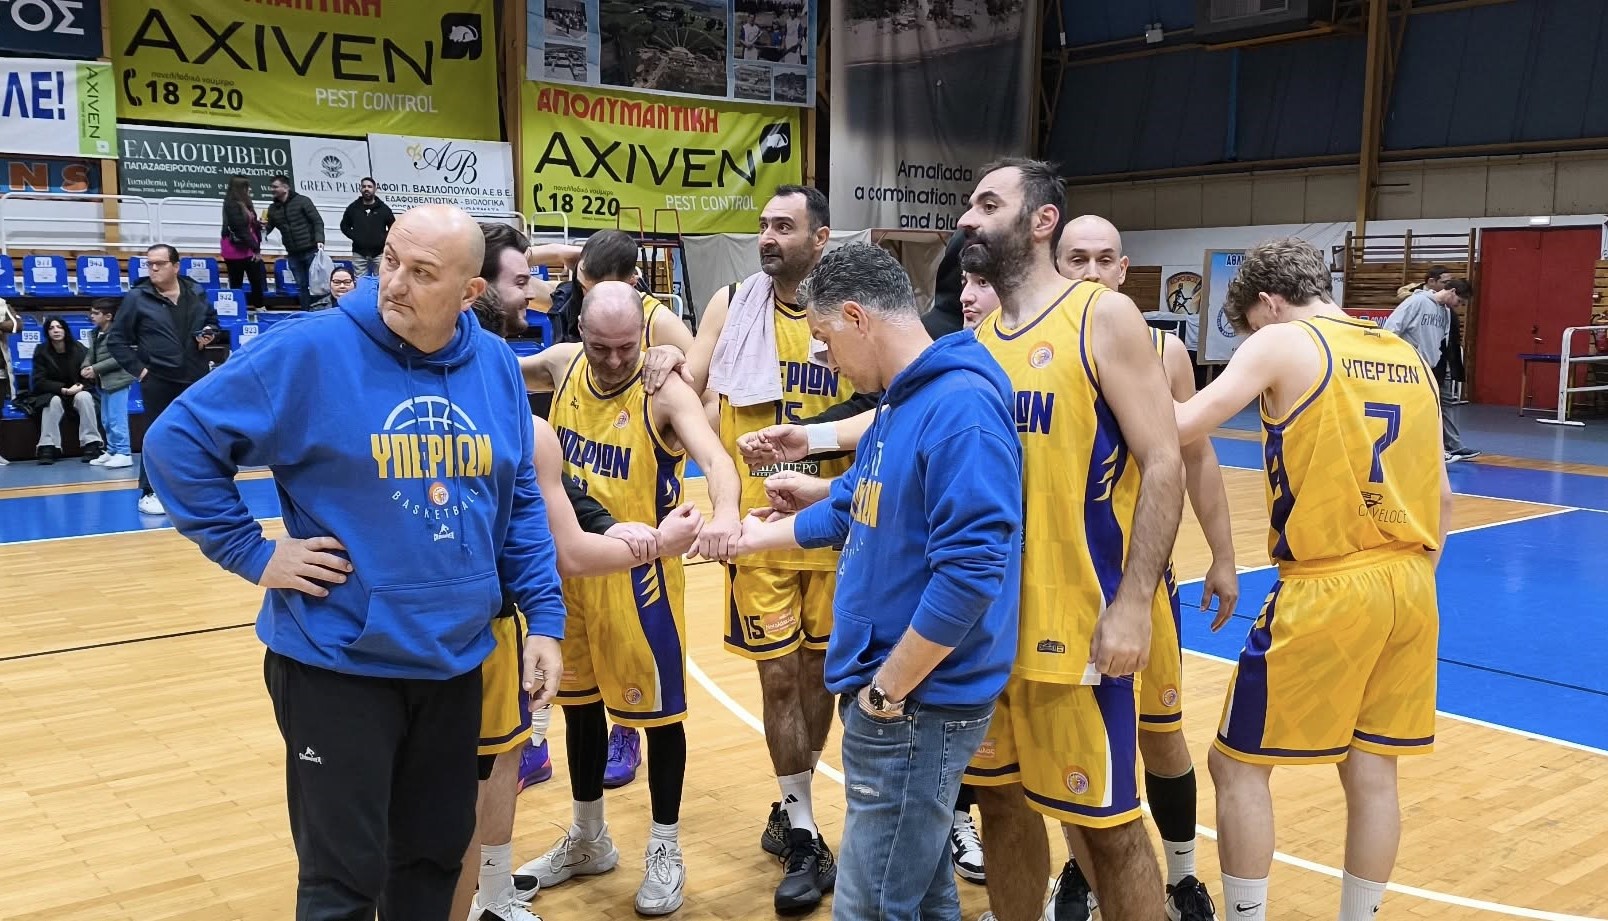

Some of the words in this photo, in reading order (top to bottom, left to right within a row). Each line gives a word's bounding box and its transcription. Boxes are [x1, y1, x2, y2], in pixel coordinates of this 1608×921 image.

[0, 0, 85, 35] ΟΣ
[124, 8, 433, 85] AXIVEN
[86, 66, 101, 139] AXIVEN
[145, 80, 180, 105] 18
[191, 84, 243, 111] 220
[316, 88, 358, 109] PEST
[363, 92, 438, 113] CONTROL
[537, 88, 719, 134] ΑΠΟΛΥΜΑΝΤΙΚΗ
[123, 139, 288, 167] ΕΛΑΙΟΤΡΙΒΕΙΟ
[534, 131, 757, 188] AXIVEN
[898, 160, 973, 182] Amaliada
[300, 180, 333, 192] GREEN
[335, 181, 361, 193] PEAR
[413, 184, 480, 195] ΒΑΣΙΛΟΠΟΥΛΟΙ
[855, 185, 864, 201] a
[868, 187, 956, 206] combination
[548, 192, 573, 213] 18
[582, 195, 621, 216] 220
[665, 194, 696, 211] PEST
[701, 195, 758, 212] CONTROL
[900, 212, 931, 229] and
[935, 213, 959, 231] blu
[23, 332, 39, 341] 956
[1342, 358, 1420, 385] ΥΠΕΡΙΩΝ
[370, 433, 493, 479] ΥΠΕΡΙΩΝ
[1364, 402, 1401, 483] 7
[391, 488, 479, 520] BASKETBALL
[744, 615, 766, 640] 15
